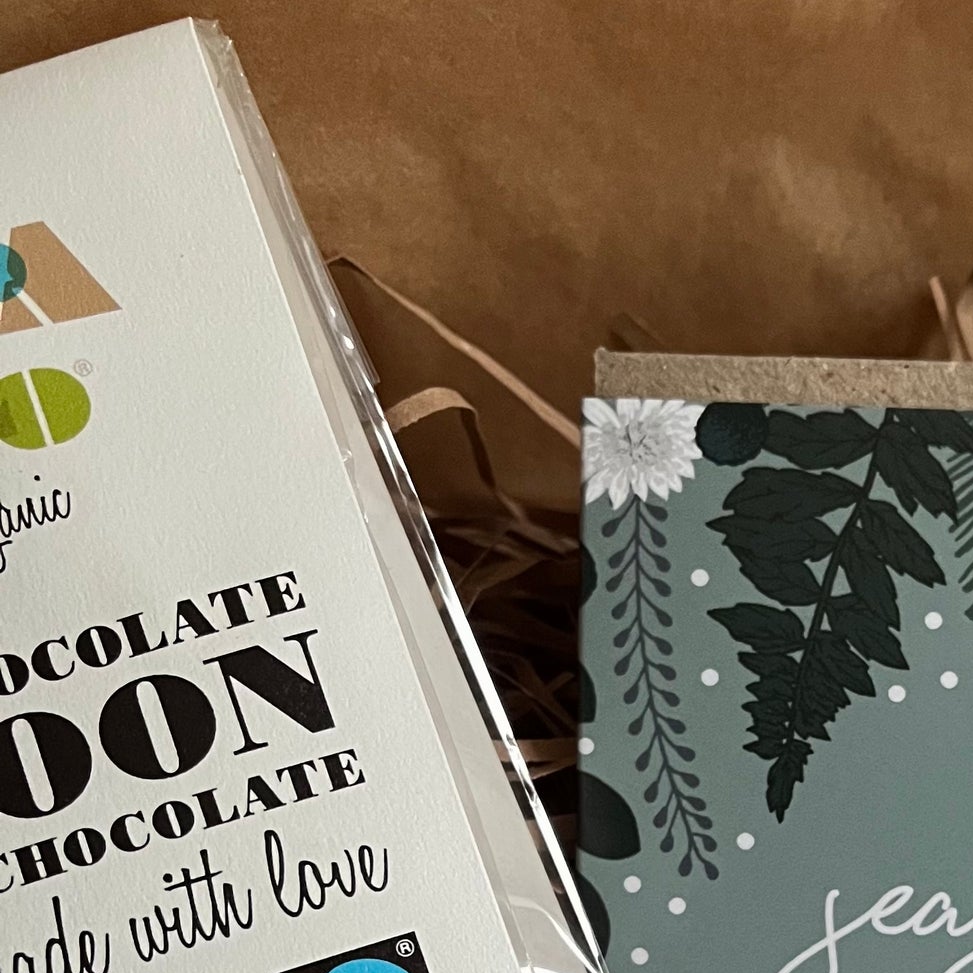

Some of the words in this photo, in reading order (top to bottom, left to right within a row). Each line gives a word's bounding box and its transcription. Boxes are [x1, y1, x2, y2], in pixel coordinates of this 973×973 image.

[0, 474, 71, 574] anic
[0, 629, 336, 819] OON
[129, 849, 253, 960] with
[264, 829, 389, 917] love
